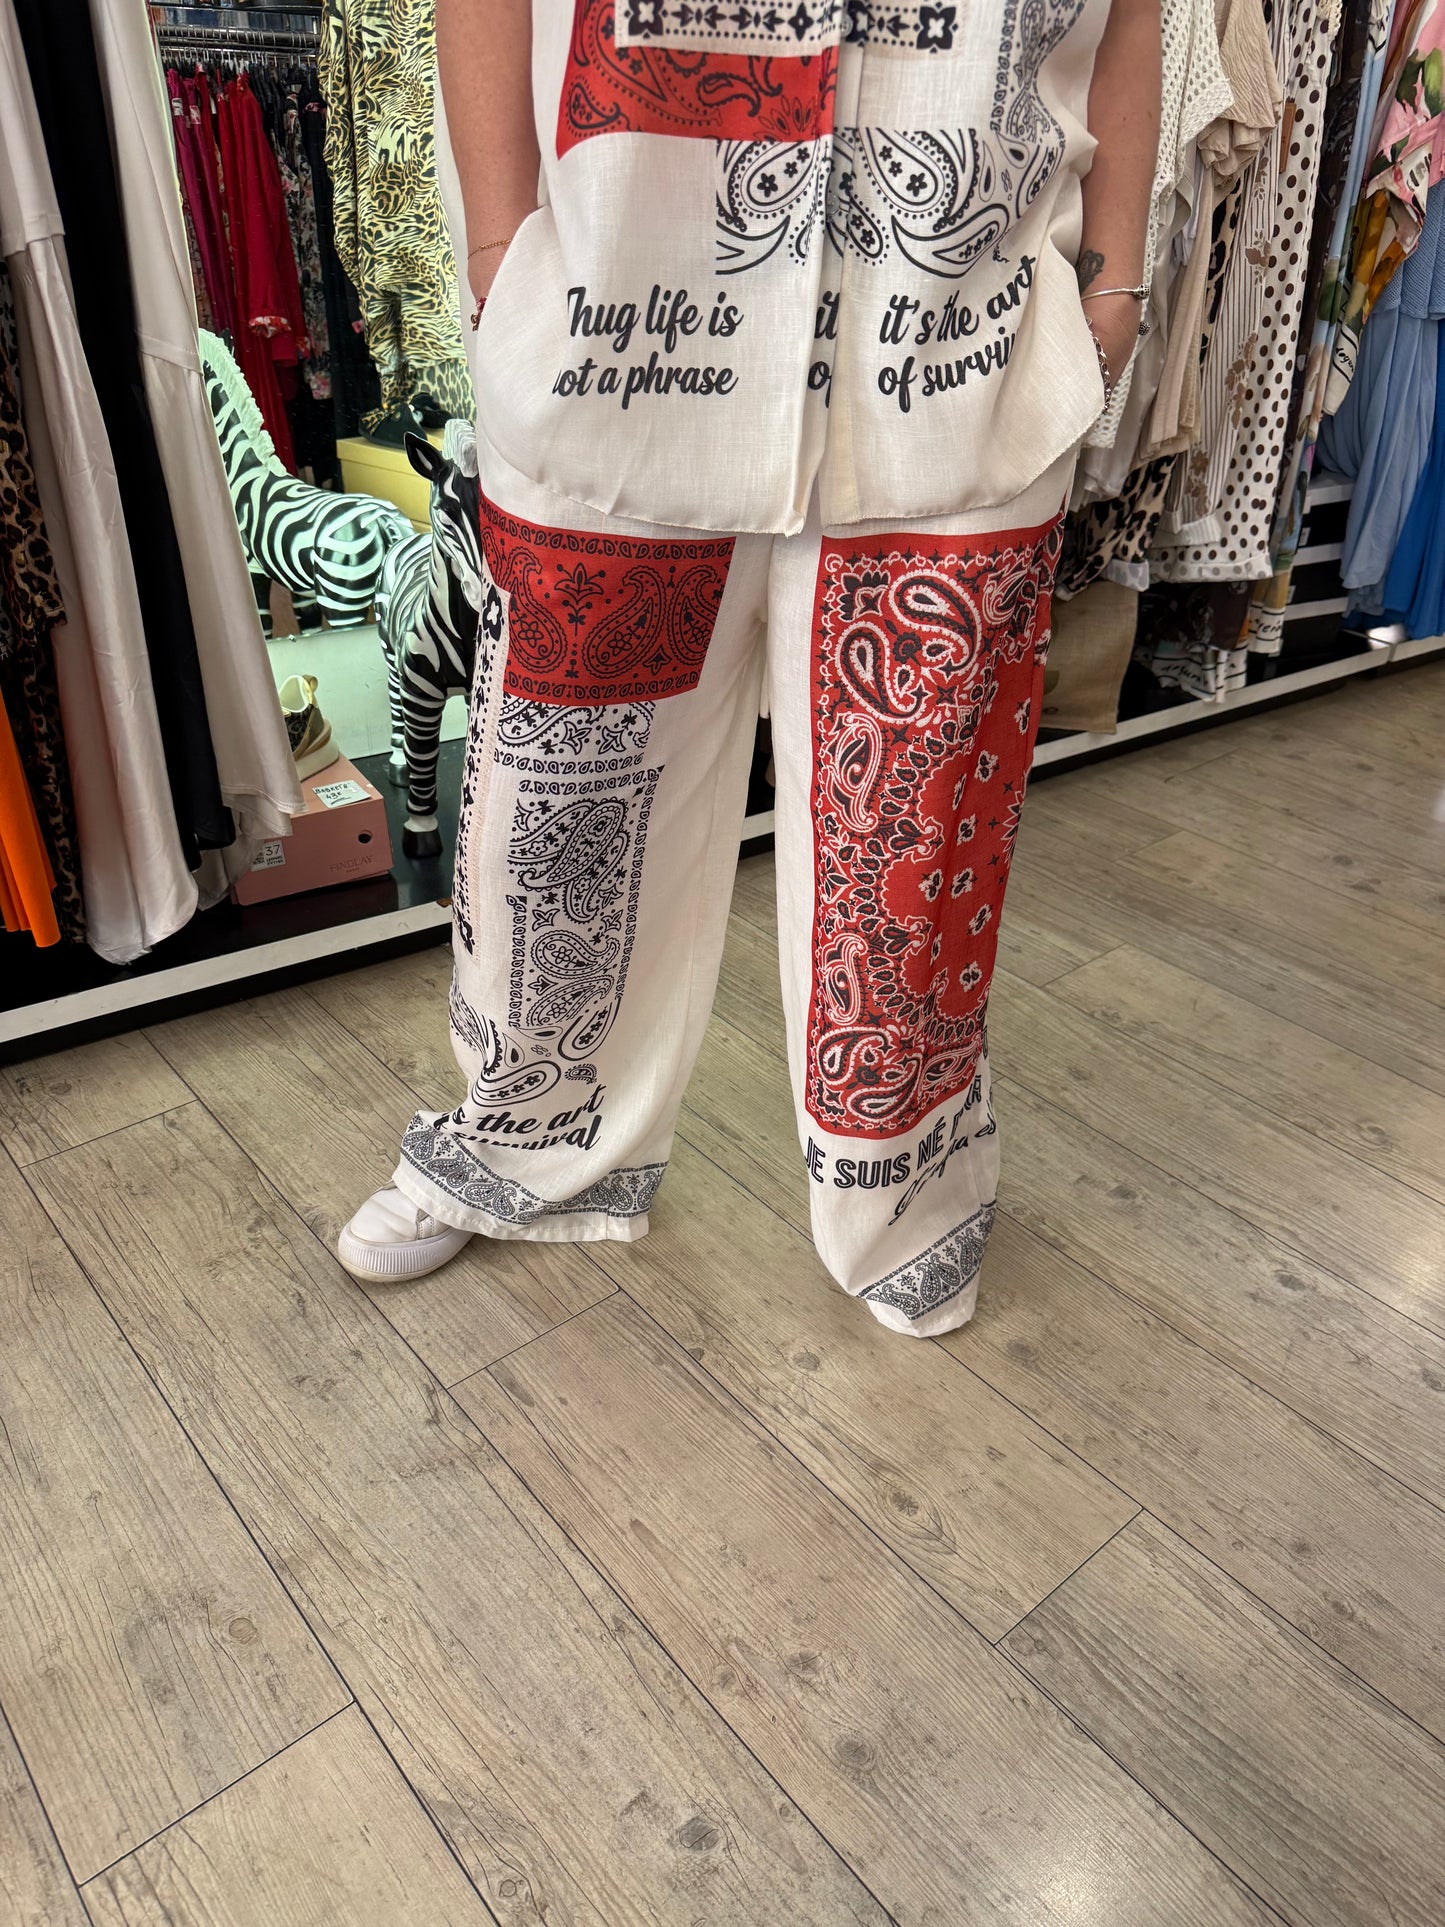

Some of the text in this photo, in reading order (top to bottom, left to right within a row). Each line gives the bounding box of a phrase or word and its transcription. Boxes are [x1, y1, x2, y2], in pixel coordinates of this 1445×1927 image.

[645, 284, 703, 353] life
[708, 291, 744, 337] is
[879, 255, 1037, 346] it's the art
[552, 351, 739, 410] ot a phrase
[878, 326, 1019, 413] of survi
[265, 844, 280, 856] 37
[476, 1112, 542, 1134] the
[547, 1084, 606, 1130] art
[833, 1152, 911, 1190] SUIS
[917, 1115, 946, 1171] NÉ
